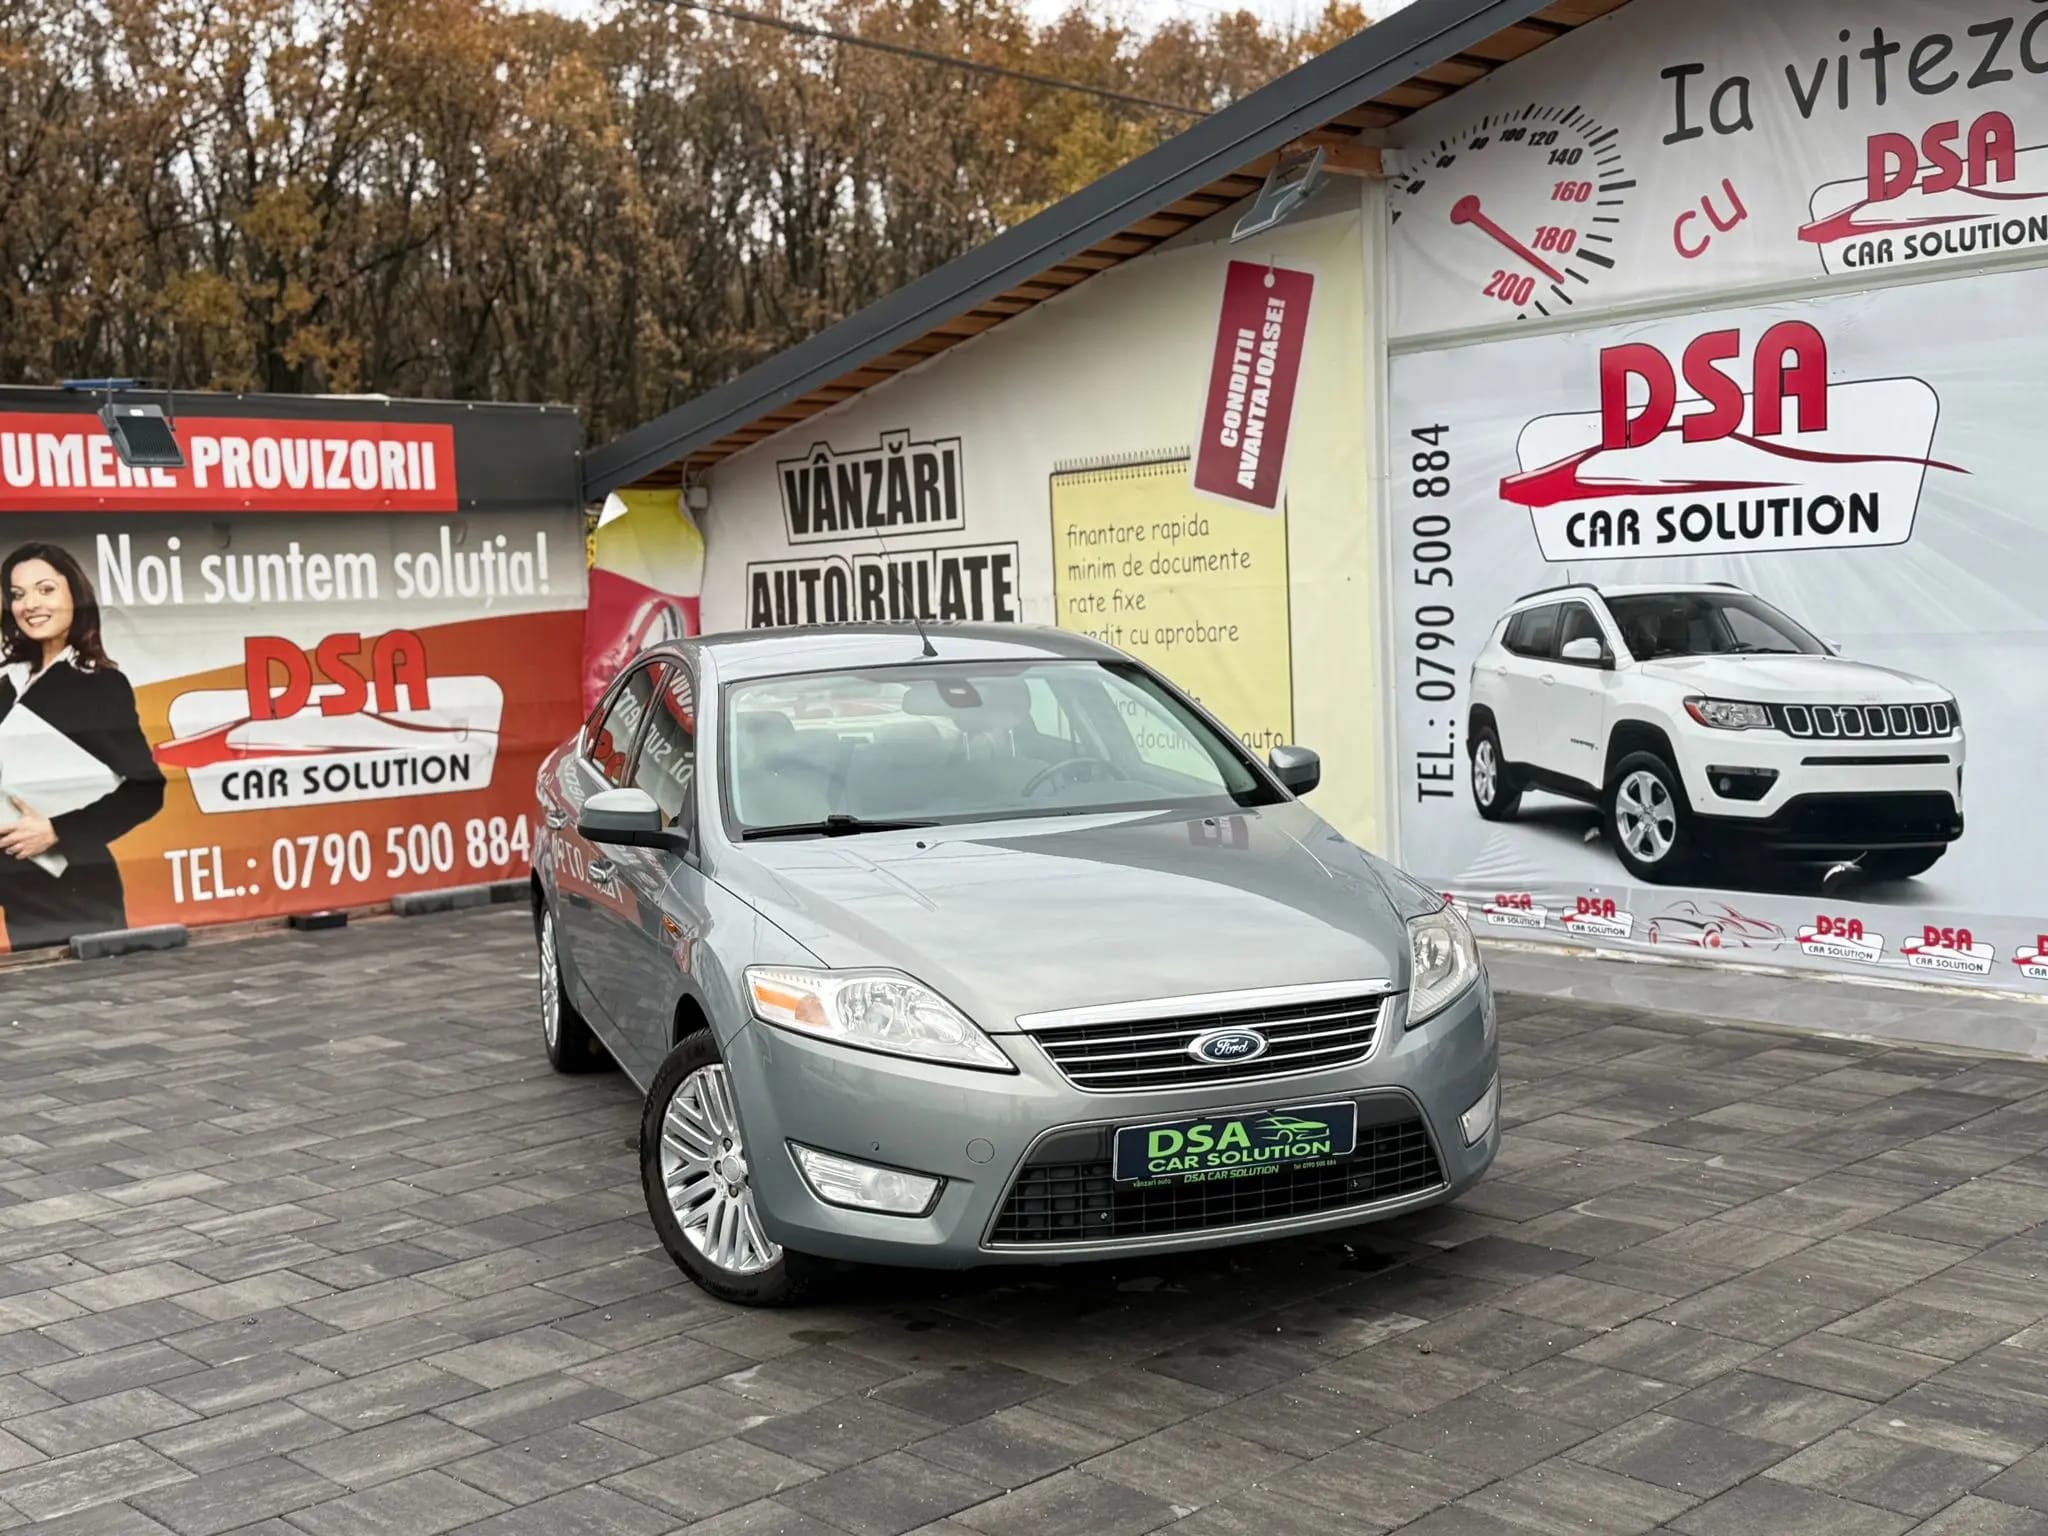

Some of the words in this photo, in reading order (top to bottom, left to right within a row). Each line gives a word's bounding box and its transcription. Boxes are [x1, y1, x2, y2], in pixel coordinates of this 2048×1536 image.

[1661, 62, 1753, 145] Ia
[1528, 130, 1558, 146] 120
[1867, 111, 2016, 201] DSA
[1547, 148, 1583, 166] 140
[1551, 181, 1592, 203] 160
[1673, 178, 1748, 258] cu
[1531, 226, 1577, 254] 180
[1843, 237, 1893, 267] CAR
[1904, 214, 2048, 260] SOLUTION
[1482, 270, 1536, 306] 200
[1220, 328, 1256, 447] CONDITII
[1237, 297, 1286, 490] AVANTAJOASE!
[1601, 321, 1827, 449] DSA
[191, 436, 436, 491] PROVIZORII
[1411, 423, 1451, 498] 884
[784, 441, 958, 534] VÂNZĂRI
[1067, 523, 1145, 548] finantare
[1151, 512, 1210, 545] rapida
[1566, 510, 1641, 548] CAR
[1657, 492, 1879, 543] SOLUTION
[97, 533, 182, 606] Noi
[200, 541, 378, 602] suntem
[396, 525, 550, 609] soluția!
[1068, 556, 1116, 581] minim
[1122, 554, 1143, 577] de
[1150, 548, 1251, 574] documente
[1412, 514, 1453, 587] 500
[751, 565, 849, 628] AUTO
[860, 554, 1014, 622] RULATE
[1069, 593, 1106, 614] rate
[1113, 589, 1146, 612] fixe
[1083, 623, 1123, 646] edit
[1130, 628, 1149, 645] cu
[1155, 620, 1239, 651] aprobare
[1415, 605, 1456, 700] 0790
[244, 628, 431, 721] DSA
[1242, 728, 1283, 748] auto
[221, 768, 289, 802] CAR
[303, 752, 471, 795] SOLUTION
[1417, 718, 1456, 802] TEL.:
[165, 849, 258, 903] TEL.:
[272, 828, 372, 890] 0790
[386, 820, 455, 879] 500
[465, 813, 530, 871] 884
[1495, 893, 1532, 911] DSA
[1576, 896, 1616, 918] DSA
[1507, 916, 1541, 928] SOLUTION
[1587, 925, 1626, 937] SOLUTION
[1816, 914, 1863, 940] DSA
[1923, 925, 1972, 951] DSA
[1808, 945, 1824, 955] CAR
[1826, 946, 1873, 961] SOLUTION
[1915, 957, 1933, 967] CAR
[1935, 959, 1984, 972] SOLUTION
[1214, 1038, 1249, 1055] Ford
[1148, 1121, 1251, 1158] DSA
[1148, 1155, 1199, 1172] CAR
[1206, 1140, 1330, 1166] SOLUTION
[1184, 1172, 1206, 1183] DSA
[1207, 1168, 1228, 1181] CAR
[1229, 1164, 1279, 1178] SOLUTION
